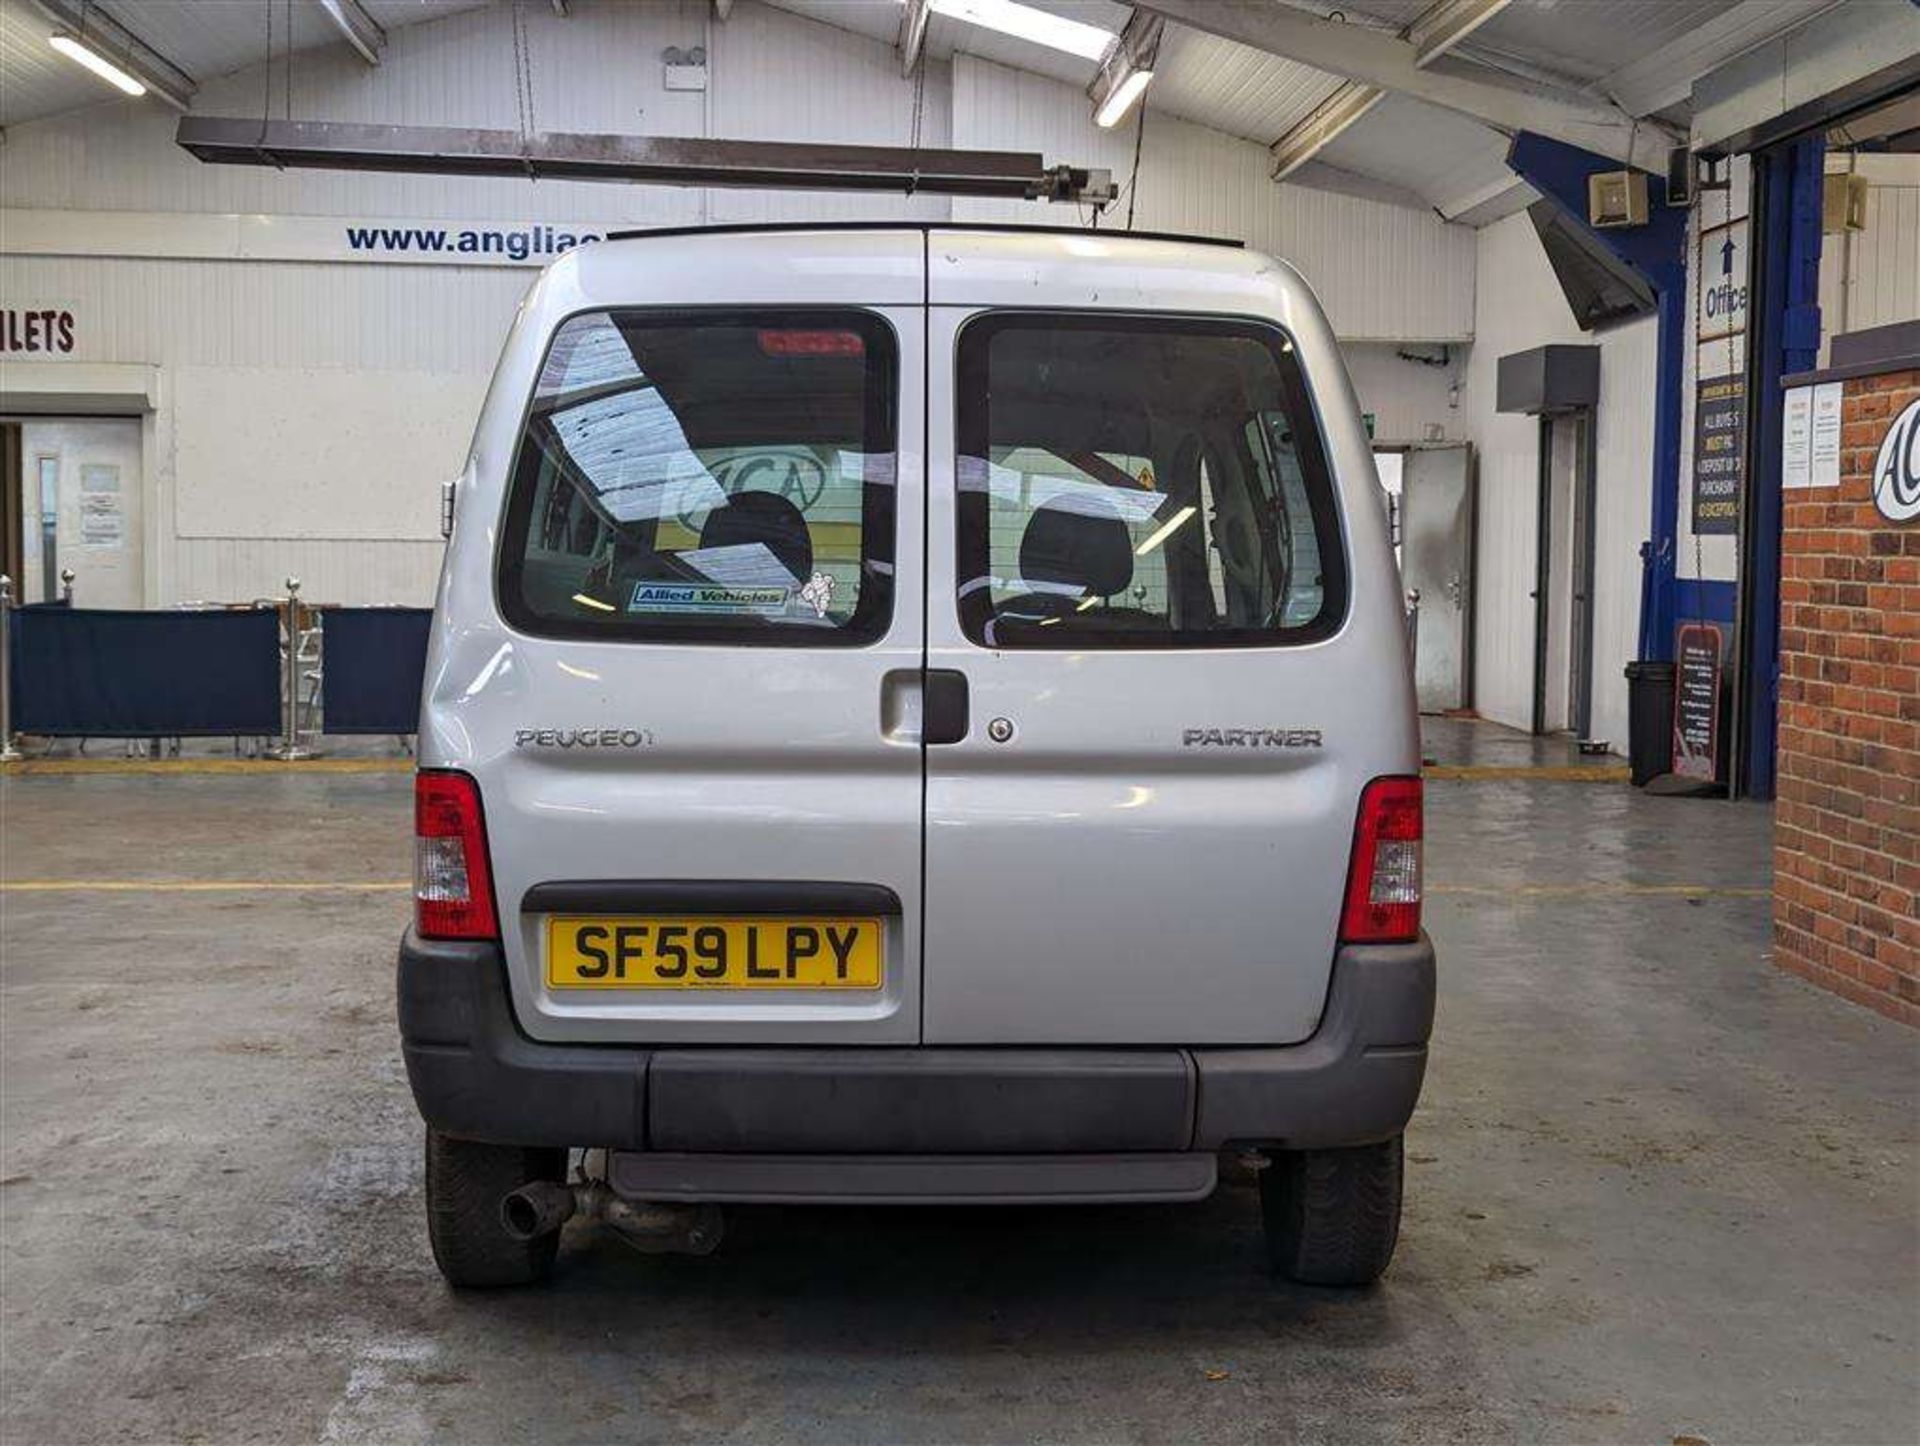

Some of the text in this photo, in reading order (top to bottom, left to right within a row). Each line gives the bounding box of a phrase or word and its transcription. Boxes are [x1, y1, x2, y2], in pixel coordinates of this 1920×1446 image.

[640, 588, 781, 604] Allied Vehicles
[1183, 729, 1323, 747] PARTNER
[575, 925, 860, 979] SF59 LPY
